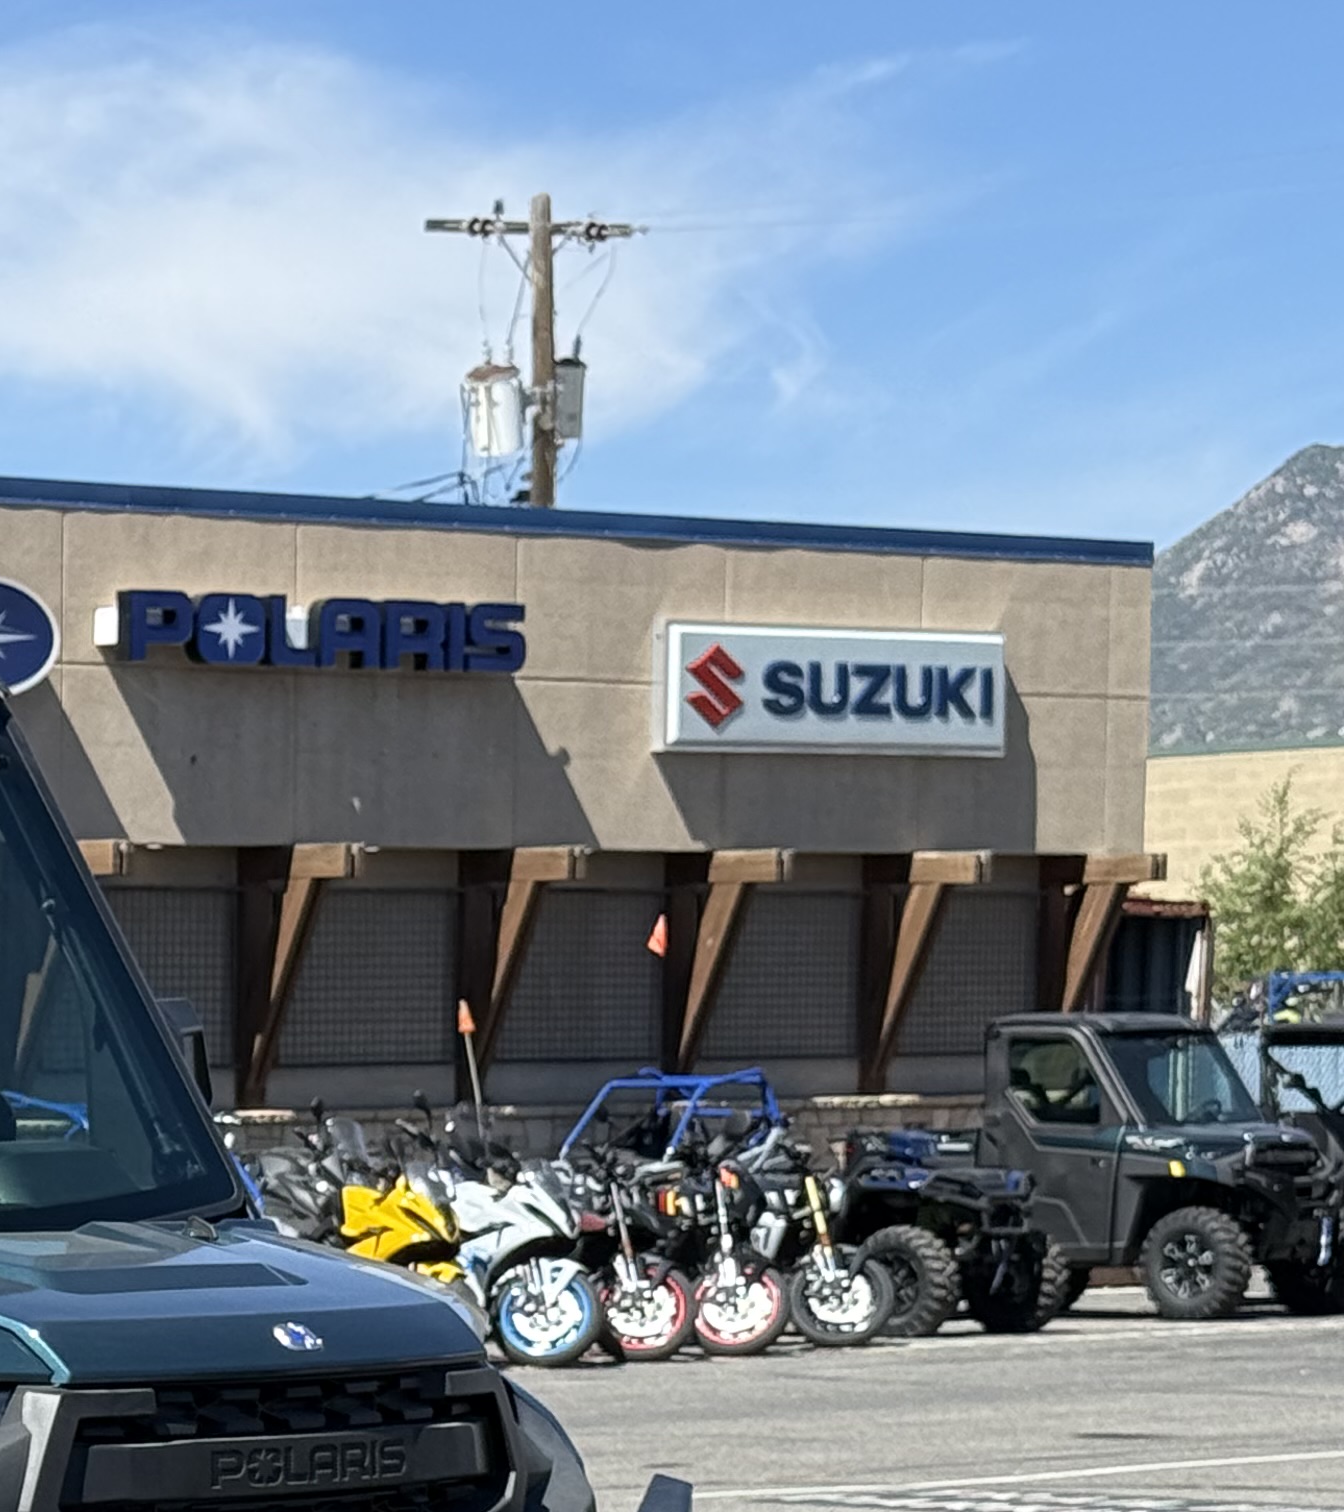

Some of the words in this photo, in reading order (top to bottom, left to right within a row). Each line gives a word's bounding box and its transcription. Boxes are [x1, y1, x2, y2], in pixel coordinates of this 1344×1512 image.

[118, 590, 527, 673] POLARIS
[762, 660, 995, 724] SUZUKI
[212, 1439, 408, 1490] POLARIS
